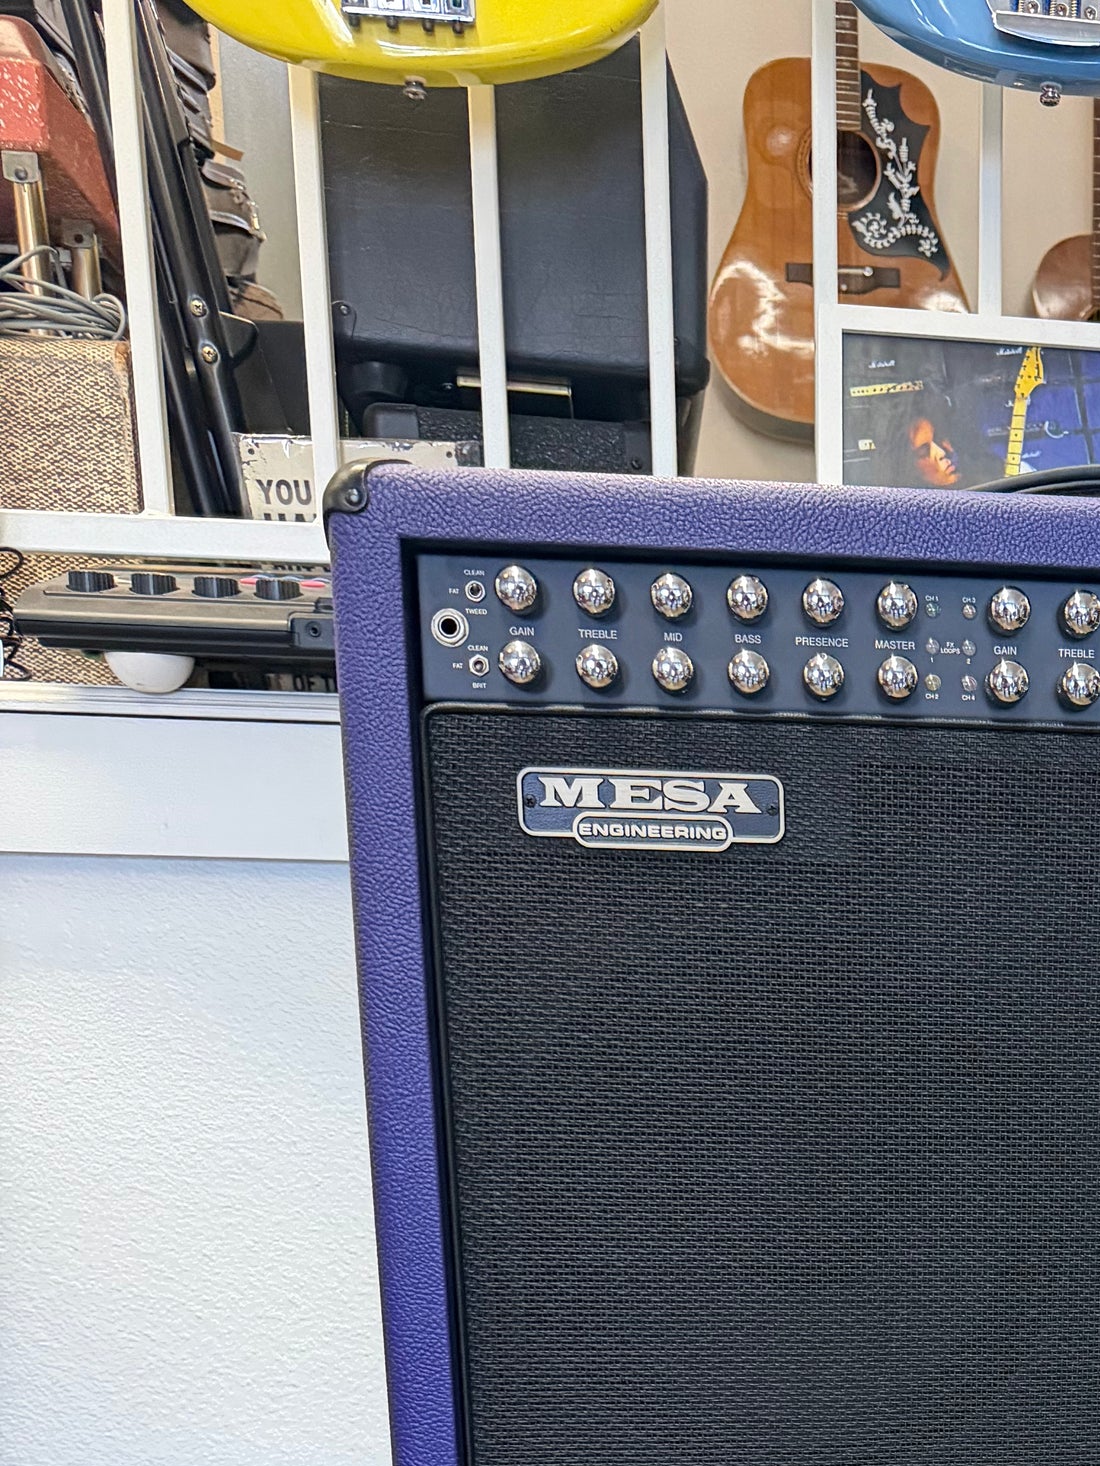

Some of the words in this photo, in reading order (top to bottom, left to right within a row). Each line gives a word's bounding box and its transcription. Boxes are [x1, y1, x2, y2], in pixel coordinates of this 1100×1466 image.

[255, 479, 312, 505] YOU
[509, 626, 535, 637] GAIN
[578, 628, 618, 640] TREBLE
[663, 632, 683, 642] MID
[734, 634, 762, 644] BASS
[795, 636, 849, 648] PRESENCE
[875, 639, 916, 651] MASTER
[993, 645, 1017, 656] GAIN
[940, 647, 960, 655] LOOPS
[1058, 648, 1095, 659] TREBLE
[538, 776, 762, 814] MESA
[578, 822, 728, 841] ENGINEERING
